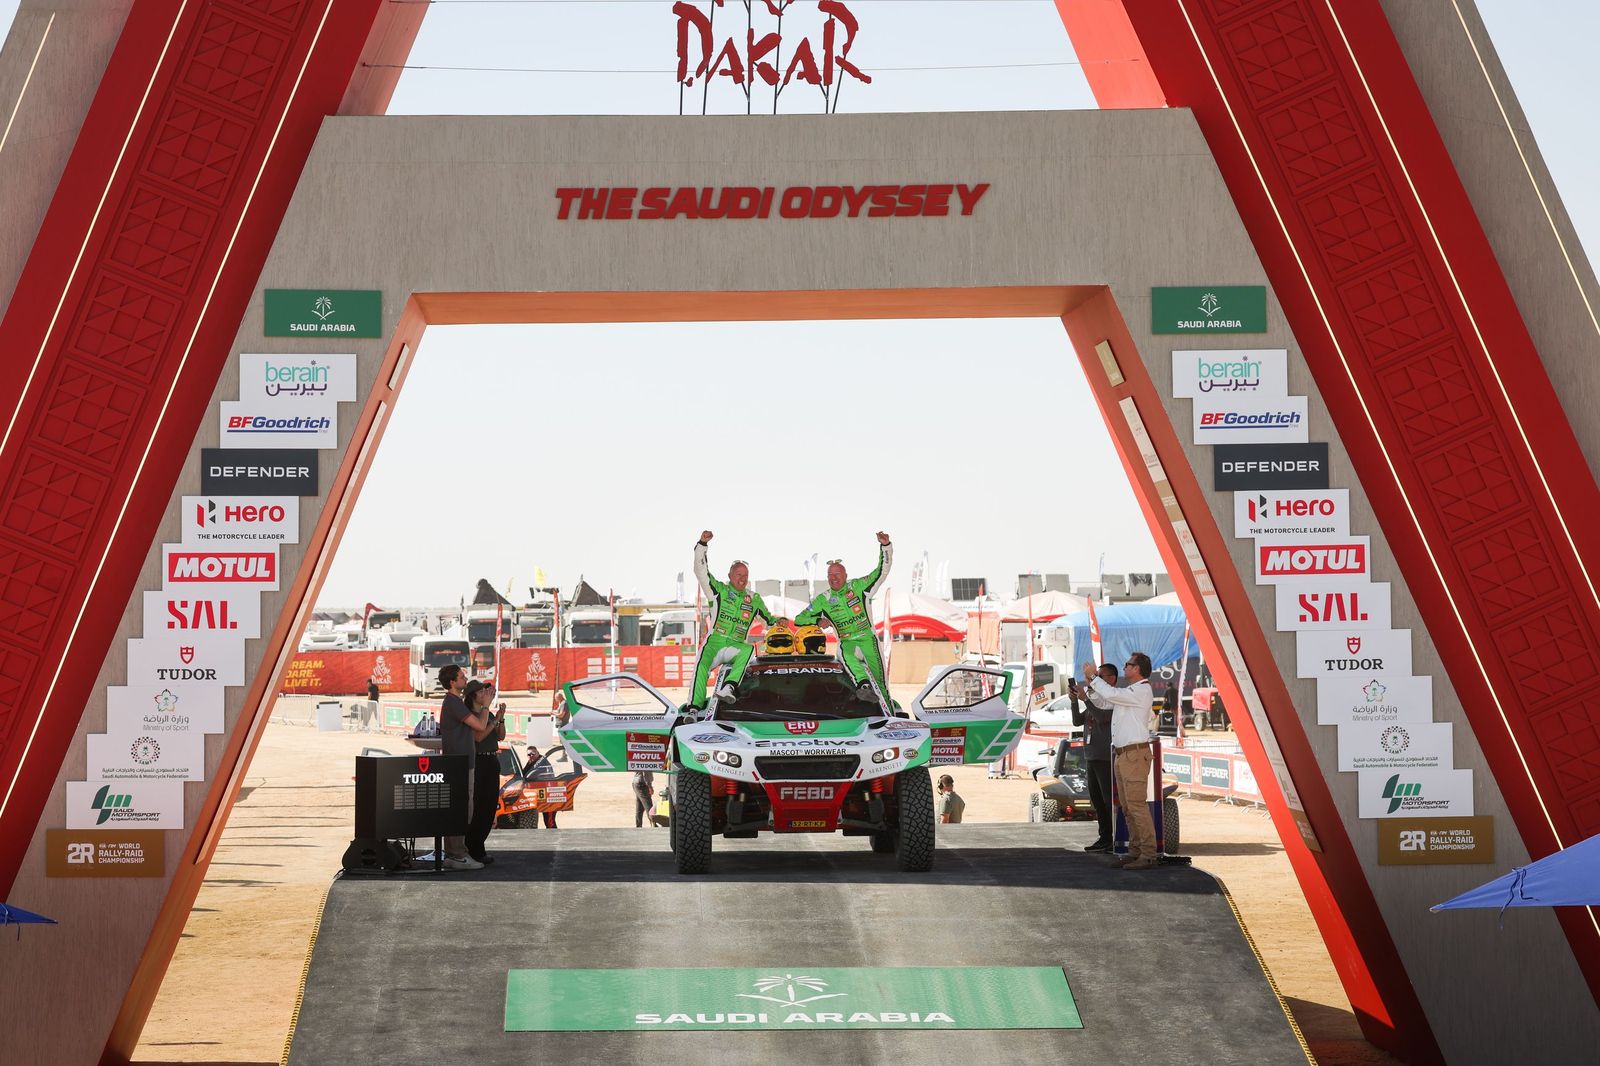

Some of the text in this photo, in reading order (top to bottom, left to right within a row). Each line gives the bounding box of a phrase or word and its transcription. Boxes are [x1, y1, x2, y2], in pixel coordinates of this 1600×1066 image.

[672, 1, 872, 87] DAKAR
[556, 183, 990, 220] THE SAUDI ODYSSEY
[290, 323, 356, 333] SAUDI ARABIA
[1177, 320, 1242, 328] SAUDI ARABIA
[265, 360, 328, 382] berain
[1198, 356, 1260, 378] berain
[265, 383, 328, 397] بيرين
[1199, 378, 1260, 393] بيرين
[228, 416, 330, 429] BFGoodrich
[1200, 412, 1301, 425] BFGoodrich
[209, 466, 310, 478] DEFENDER
[1222, 460, 1320, 473] DEFENDER
[1265, 549, 1361, 571] MOTUL
[173, 557, 270, 578] MOTUL
[1299, 592, 1368, 622] SAL
[167, 600, 238, 629] SAL
[291, 660, 325, 670] REAM.
[1325, 659, 1384, 671] TUDOR
[157, 668, 217, 681] TUDOR
[284, 678, 322, 687] LIVE IT.
[1352, 714, 1373, 722] Ministry
[1381, 714, 1398, 722] Sport
[173, 724, 189, 732] Sport
[787, 720, 816, 730] ERU
[755, 739, 860, 748] Emotive
[403, 773, 444, 784] TUDOR
[1202, 766, 1229, 780] DEFENDER
[1430, 836, 1474, 844] RALLY-RAID
[98, 849, 144, 857] RALLY-RAID
[635, 1011, 955, 1024] SAUDI ARABIA
